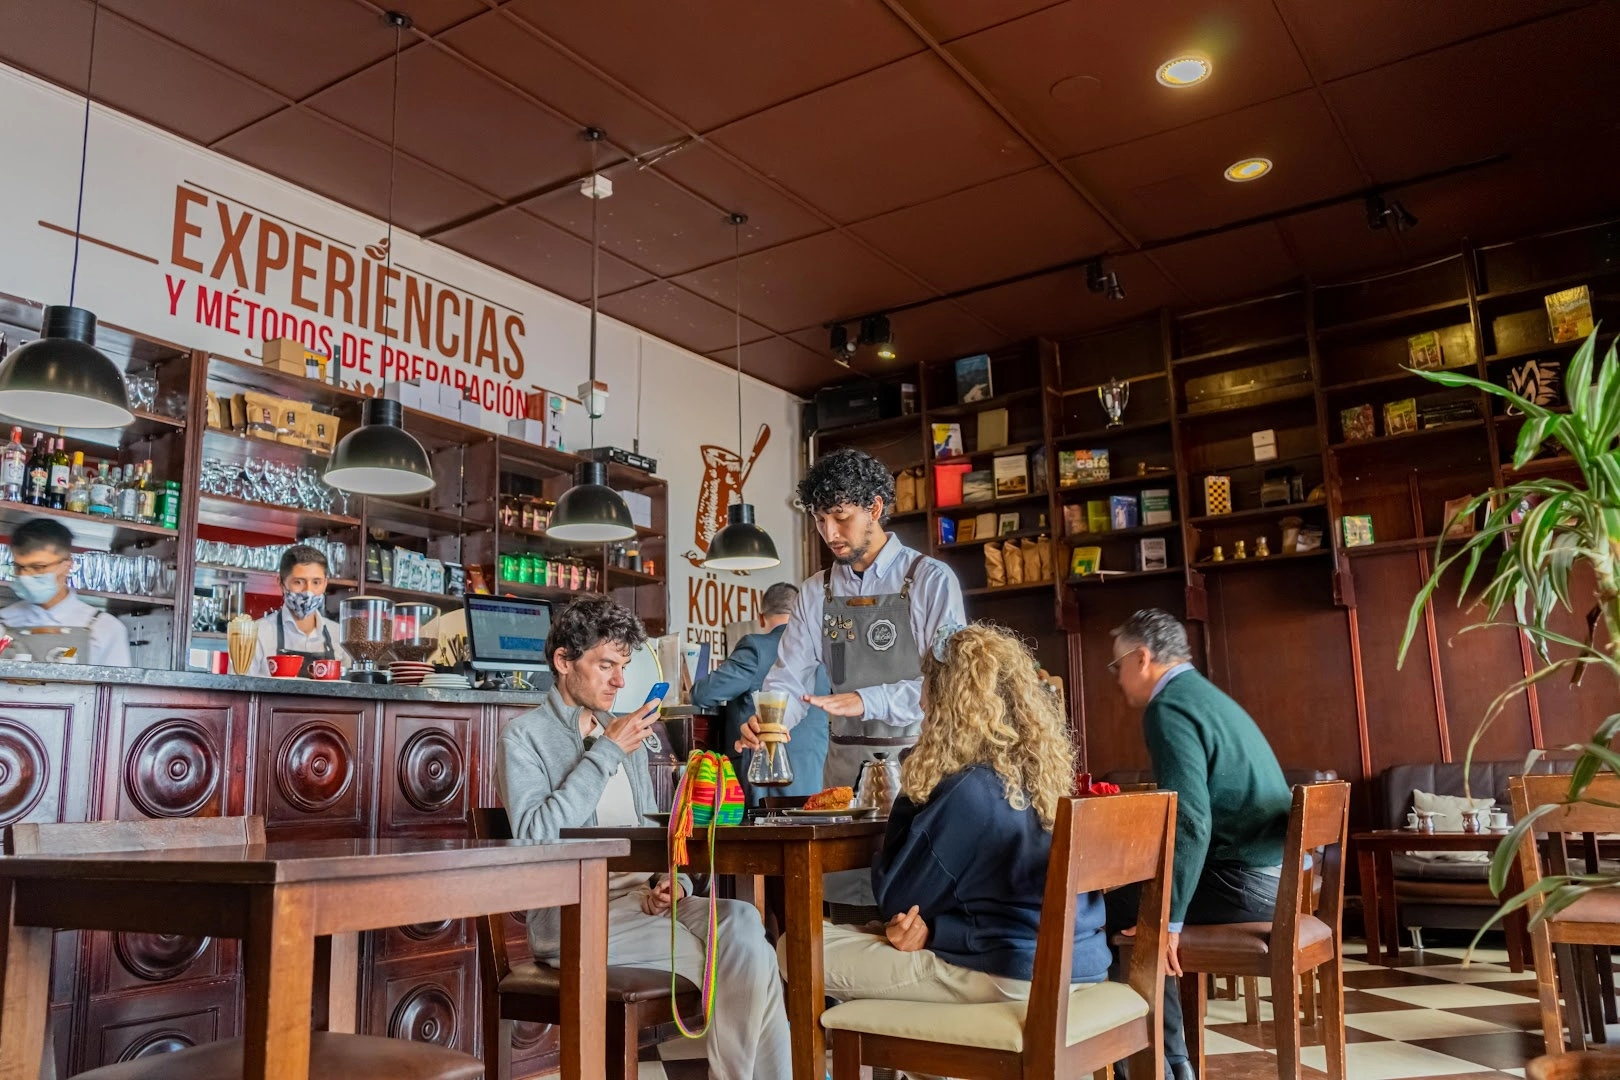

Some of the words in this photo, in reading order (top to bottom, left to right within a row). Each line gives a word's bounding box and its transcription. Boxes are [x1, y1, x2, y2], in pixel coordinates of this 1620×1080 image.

[165, 274, 186, 316] Y
[196, 285, 333, 361] MÉTODOS
[341, 332, 373, 375] DE
[380, 344, 528, 419] PREPARACIÓN
[171, 184, 525, 380] EXPERIENCIAS
[687, 627, 728, 656] EXPER
